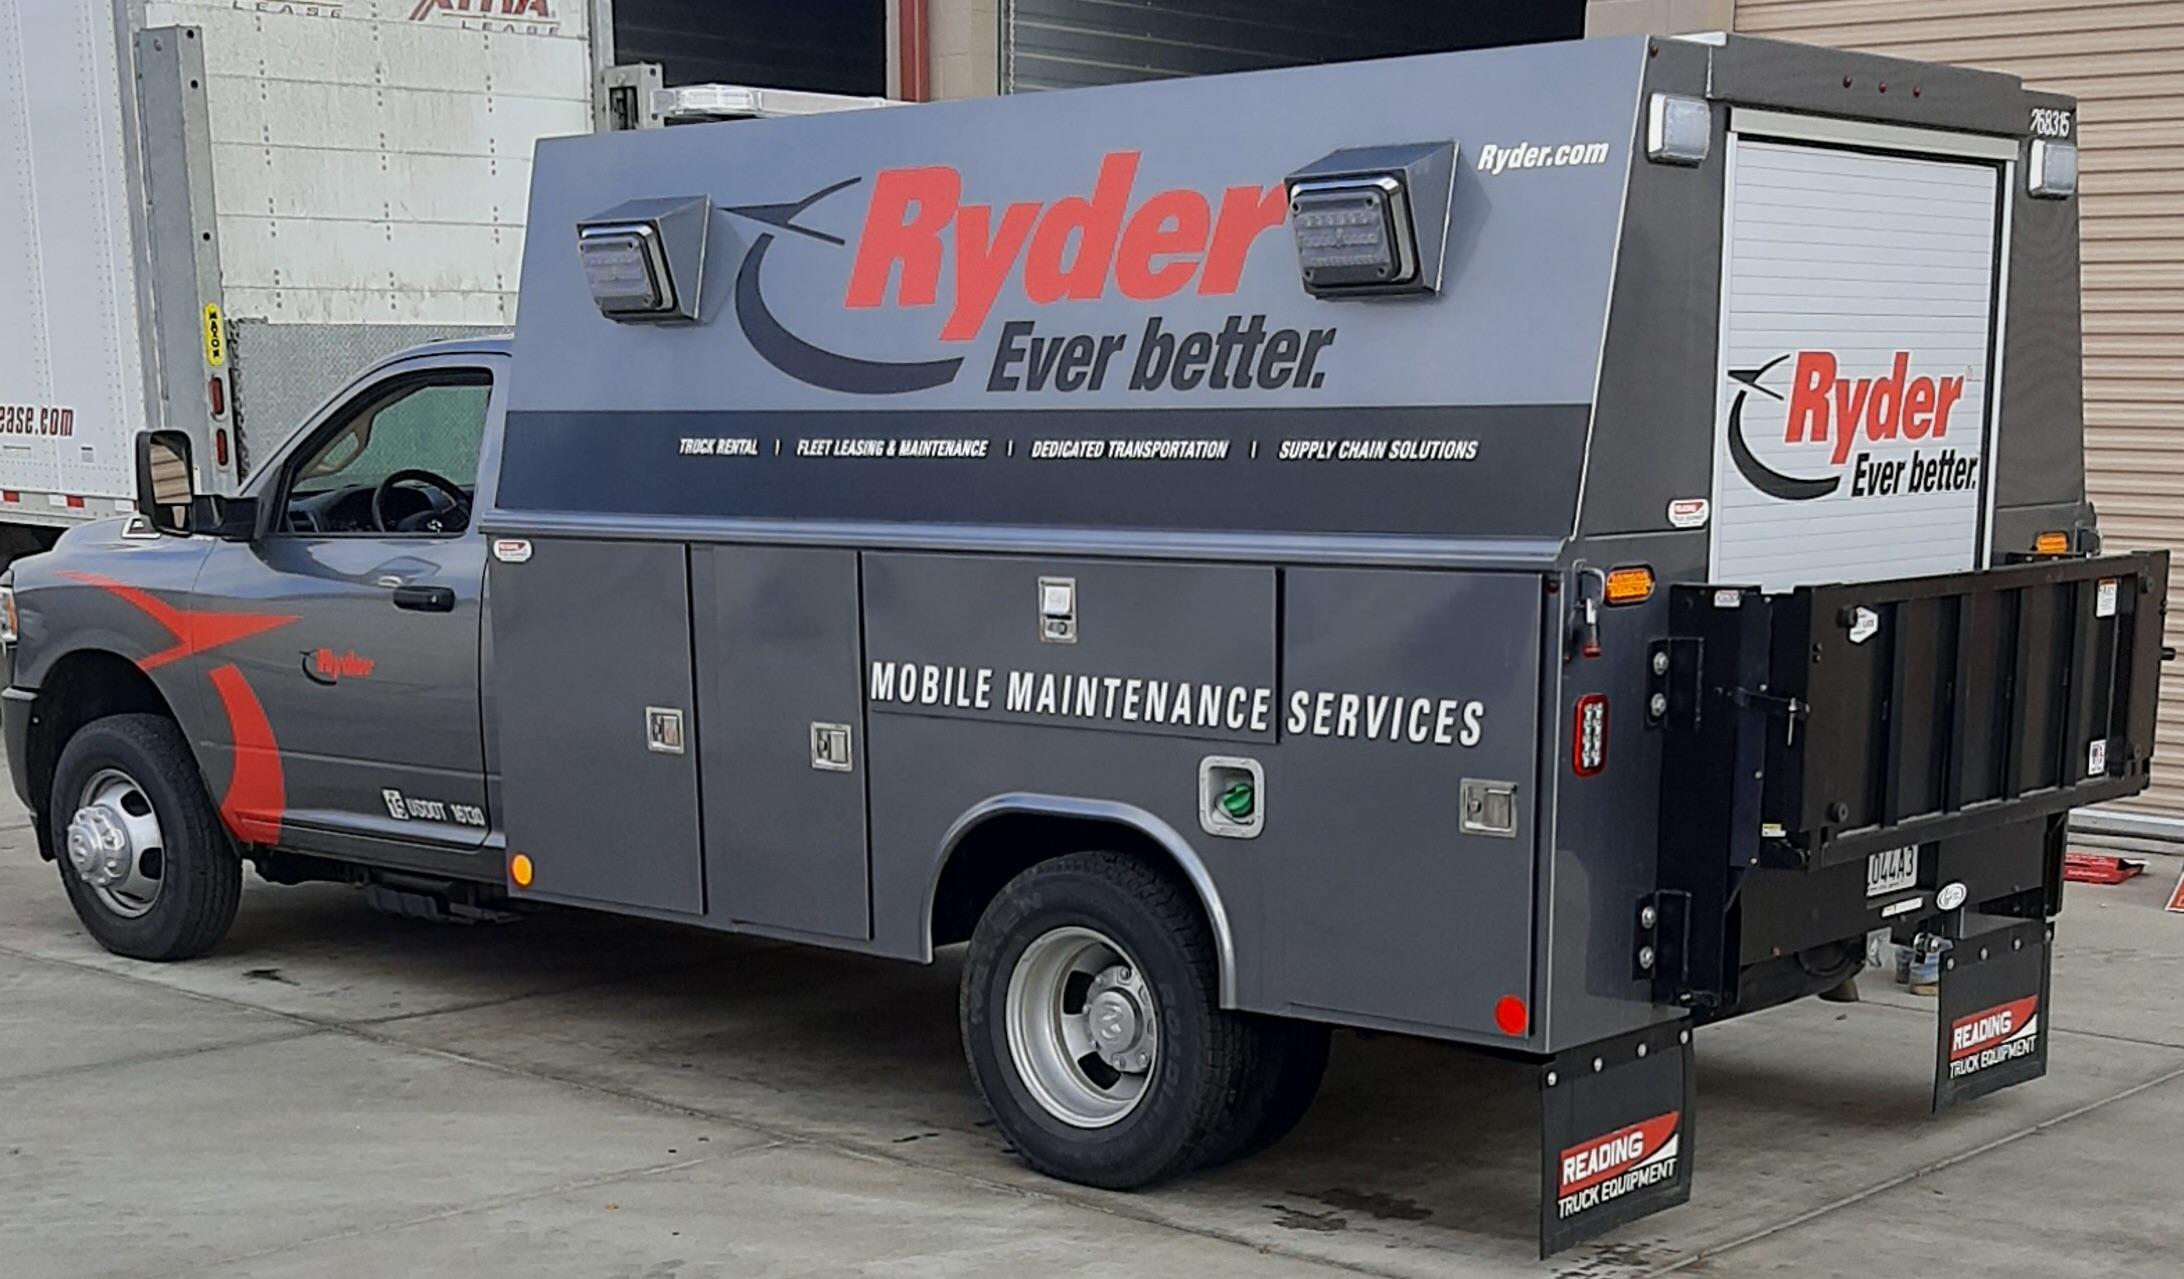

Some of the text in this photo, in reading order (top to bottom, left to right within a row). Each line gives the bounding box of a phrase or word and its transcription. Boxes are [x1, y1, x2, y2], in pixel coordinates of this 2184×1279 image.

[1477, 141, 1609, 175] Ryder.com
[844, 151, 1288, 341] Ryder
[987, 315, 1336, 392] Ever better.
[1785, 351, 1964, 465] Ryder
[680, 438, 758, 456] TRUCK RENTAL
[797, 439, 990, 457] FLEET LEASING & MAINTENANCE
[1032, 440, 1230, 459] DEDICATED TRANSPORTATION
[1279, 440, 1478, 460] SUPPLY CHAIN SOLUTIONS
[1851, 449, 1979, 497] Ever better.
[316, 648, 375, 680] Ryder
[870, 661, 1485, 747] MOBILE MAINTENANCE SERVICES
[405, 798, 448, 821] USDOT
[1953, 1010, 2013, 1052] READING
[1950, 1034, 2038, 1079] TRUCK EQUIPMENT
[1562, 1131, 1645, 1186] READING
[1558, 1158, 1678, 1219] TRUCK EQUIPMENT
